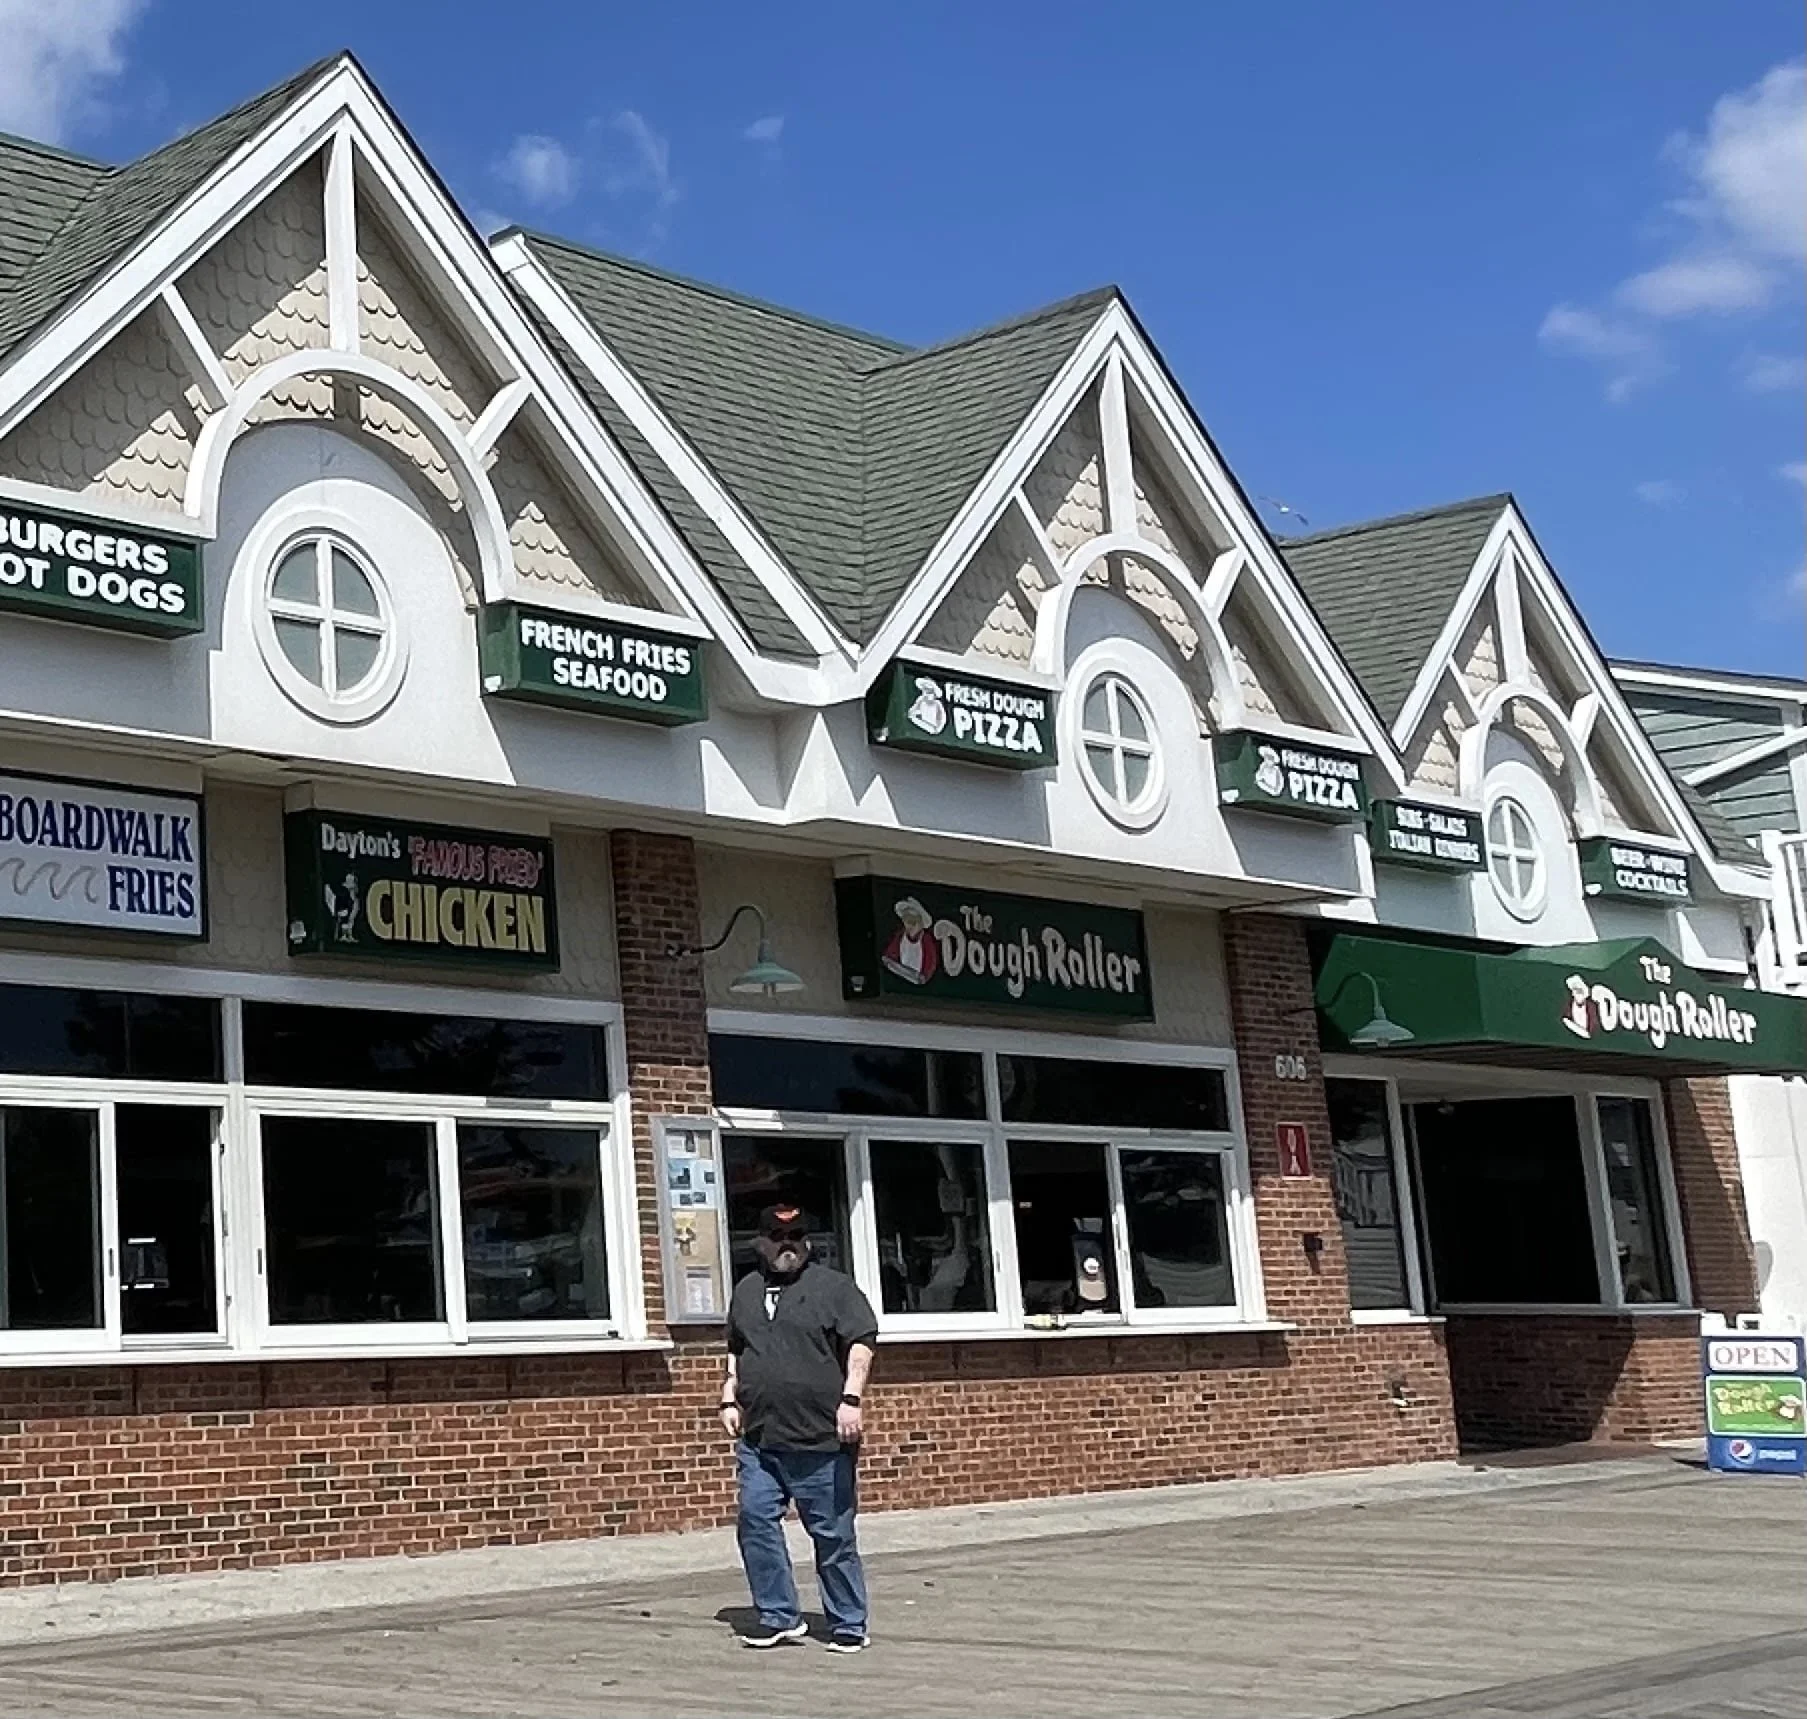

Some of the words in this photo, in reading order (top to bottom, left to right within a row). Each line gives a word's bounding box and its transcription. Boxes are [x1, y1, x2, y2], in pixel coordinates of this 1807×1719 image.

[67, 565, 185, 613] DOGS
[521, 618, 615, 661] FRENCH
[621, 637, 691, 675] FRIES
[553, 656, 667, 701] SEAFOOD
[944, 681, 991, 709] FRESH
[993, 691, 1046, 721] DOUGH
[953, 707, 1043, 753] PIZZA
[1287, 771, 1361, 811] PIZZA
[0, 794, 193, 862] BOARDWALK
[321, 822, 401, 859] Dayton's
[107, 865, 195, 918] FRIES
[1615, 869, 1689, 897] COCKTAILS
[366, 879, 546, 953] CHICKEN
[959, 905, 993, 934] The
[934, 919, 1042, 998] Dough
[1041, 927, 1141, 993] Roller
[1638, 955, 1672, 985] The
[1591, 984, 1681, 1049] Dough
[1675, 991, 1757, 1044] Roller
[1275, 1055, 1308, 1081] 606
[1714, 1345, 1791, 1366] OPEN
